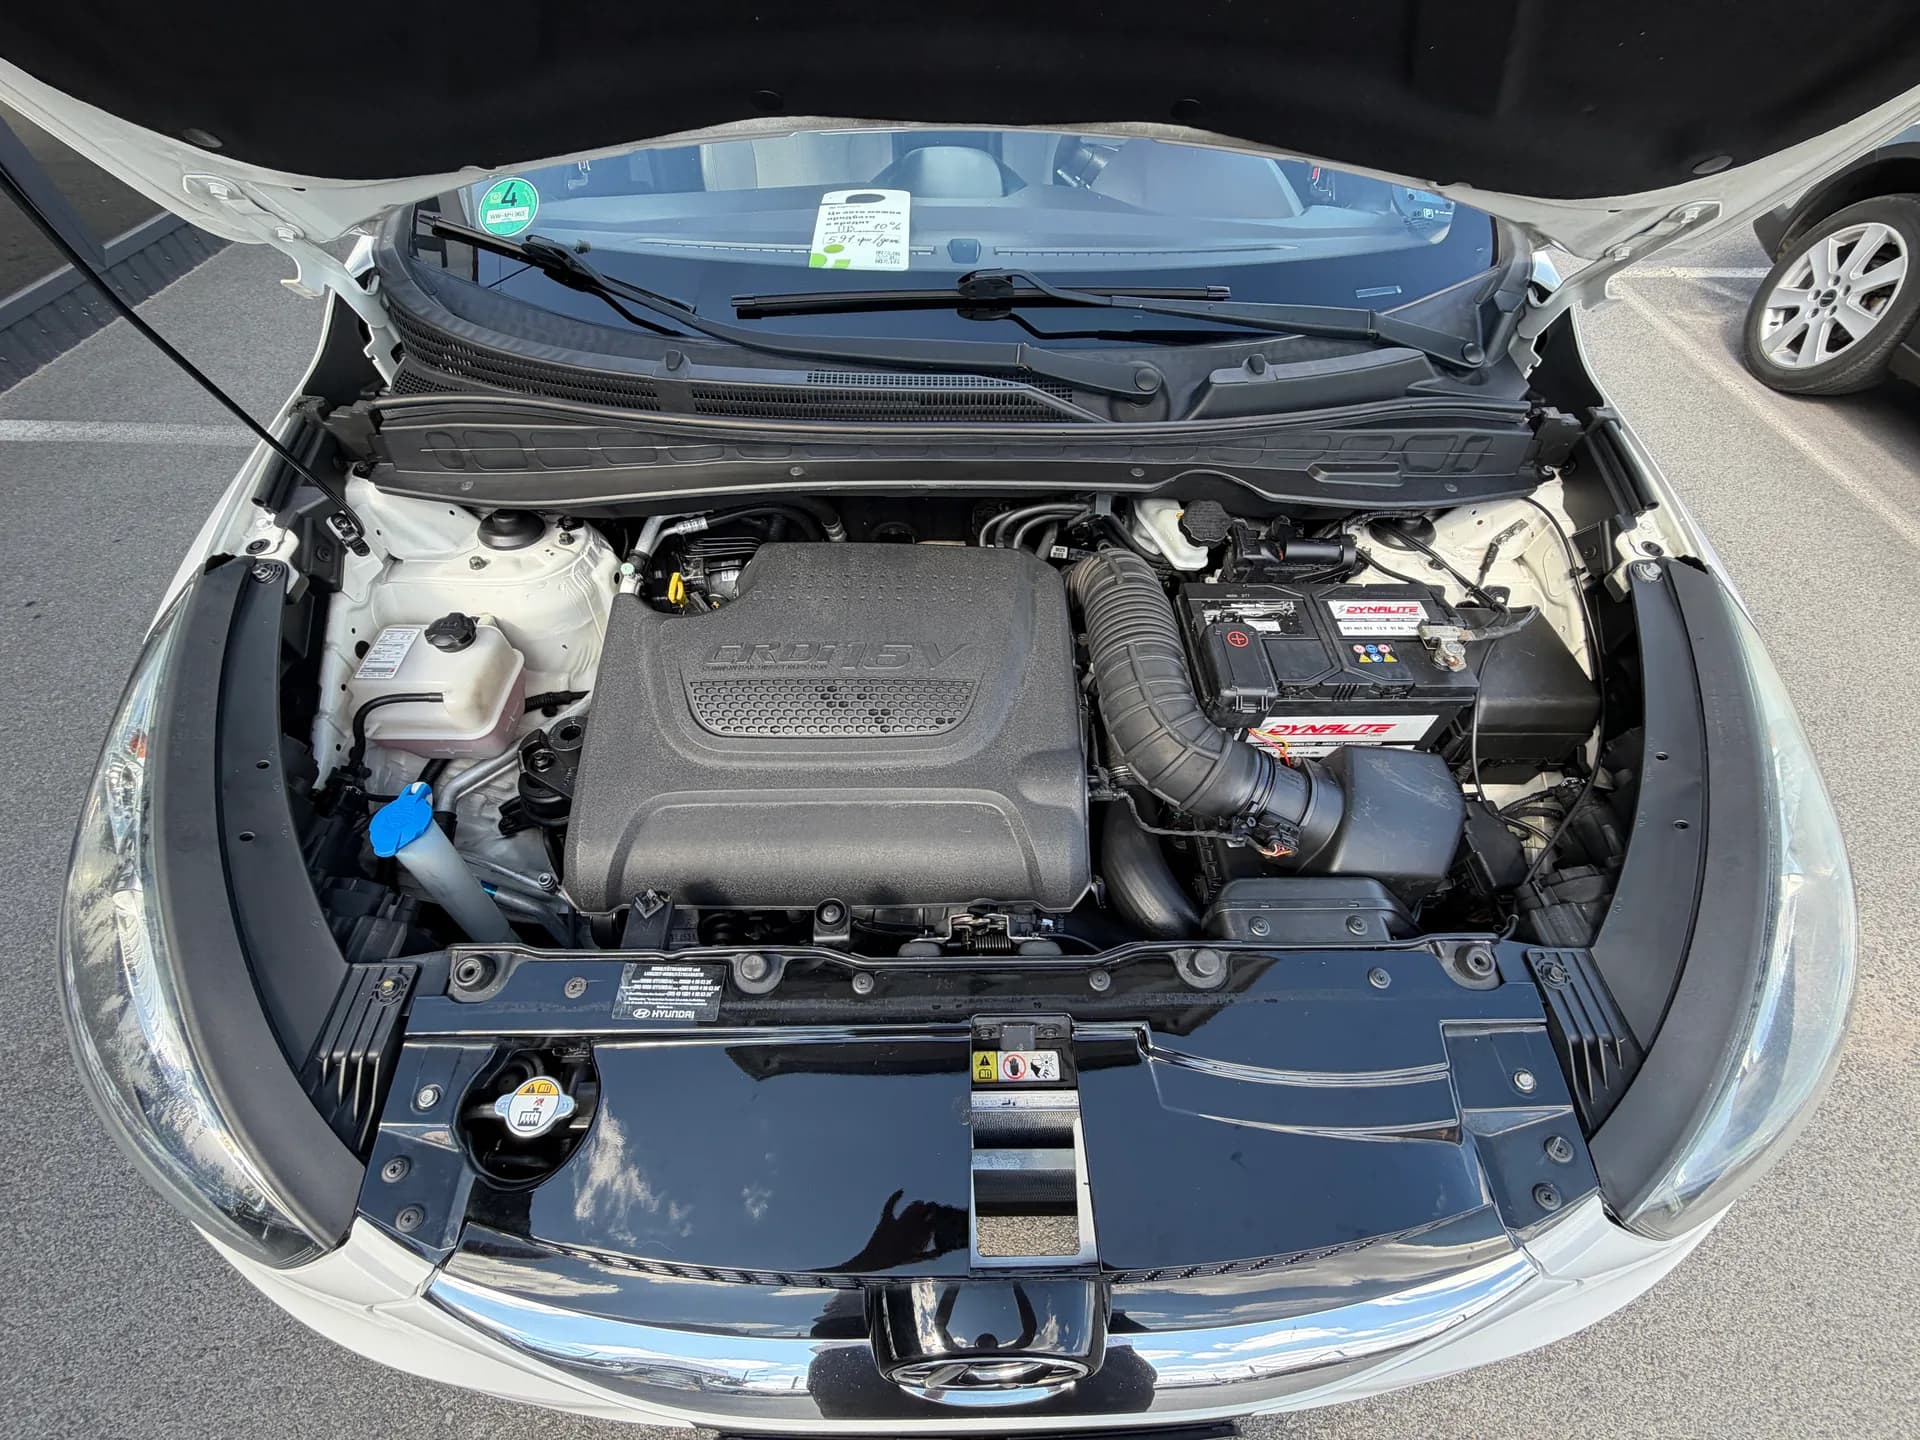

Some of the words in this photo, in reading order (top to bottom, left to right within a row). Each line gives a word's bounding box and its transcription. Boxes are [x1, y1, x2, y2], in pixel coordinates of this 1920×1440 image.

[501, 182, 517, 206] 4
[1346, 606, 1419, 614] DYNALITE
[1268, 723, 1398, 735] DYNALITE
[651, 1010, 695, 1019] HYUNDAI
